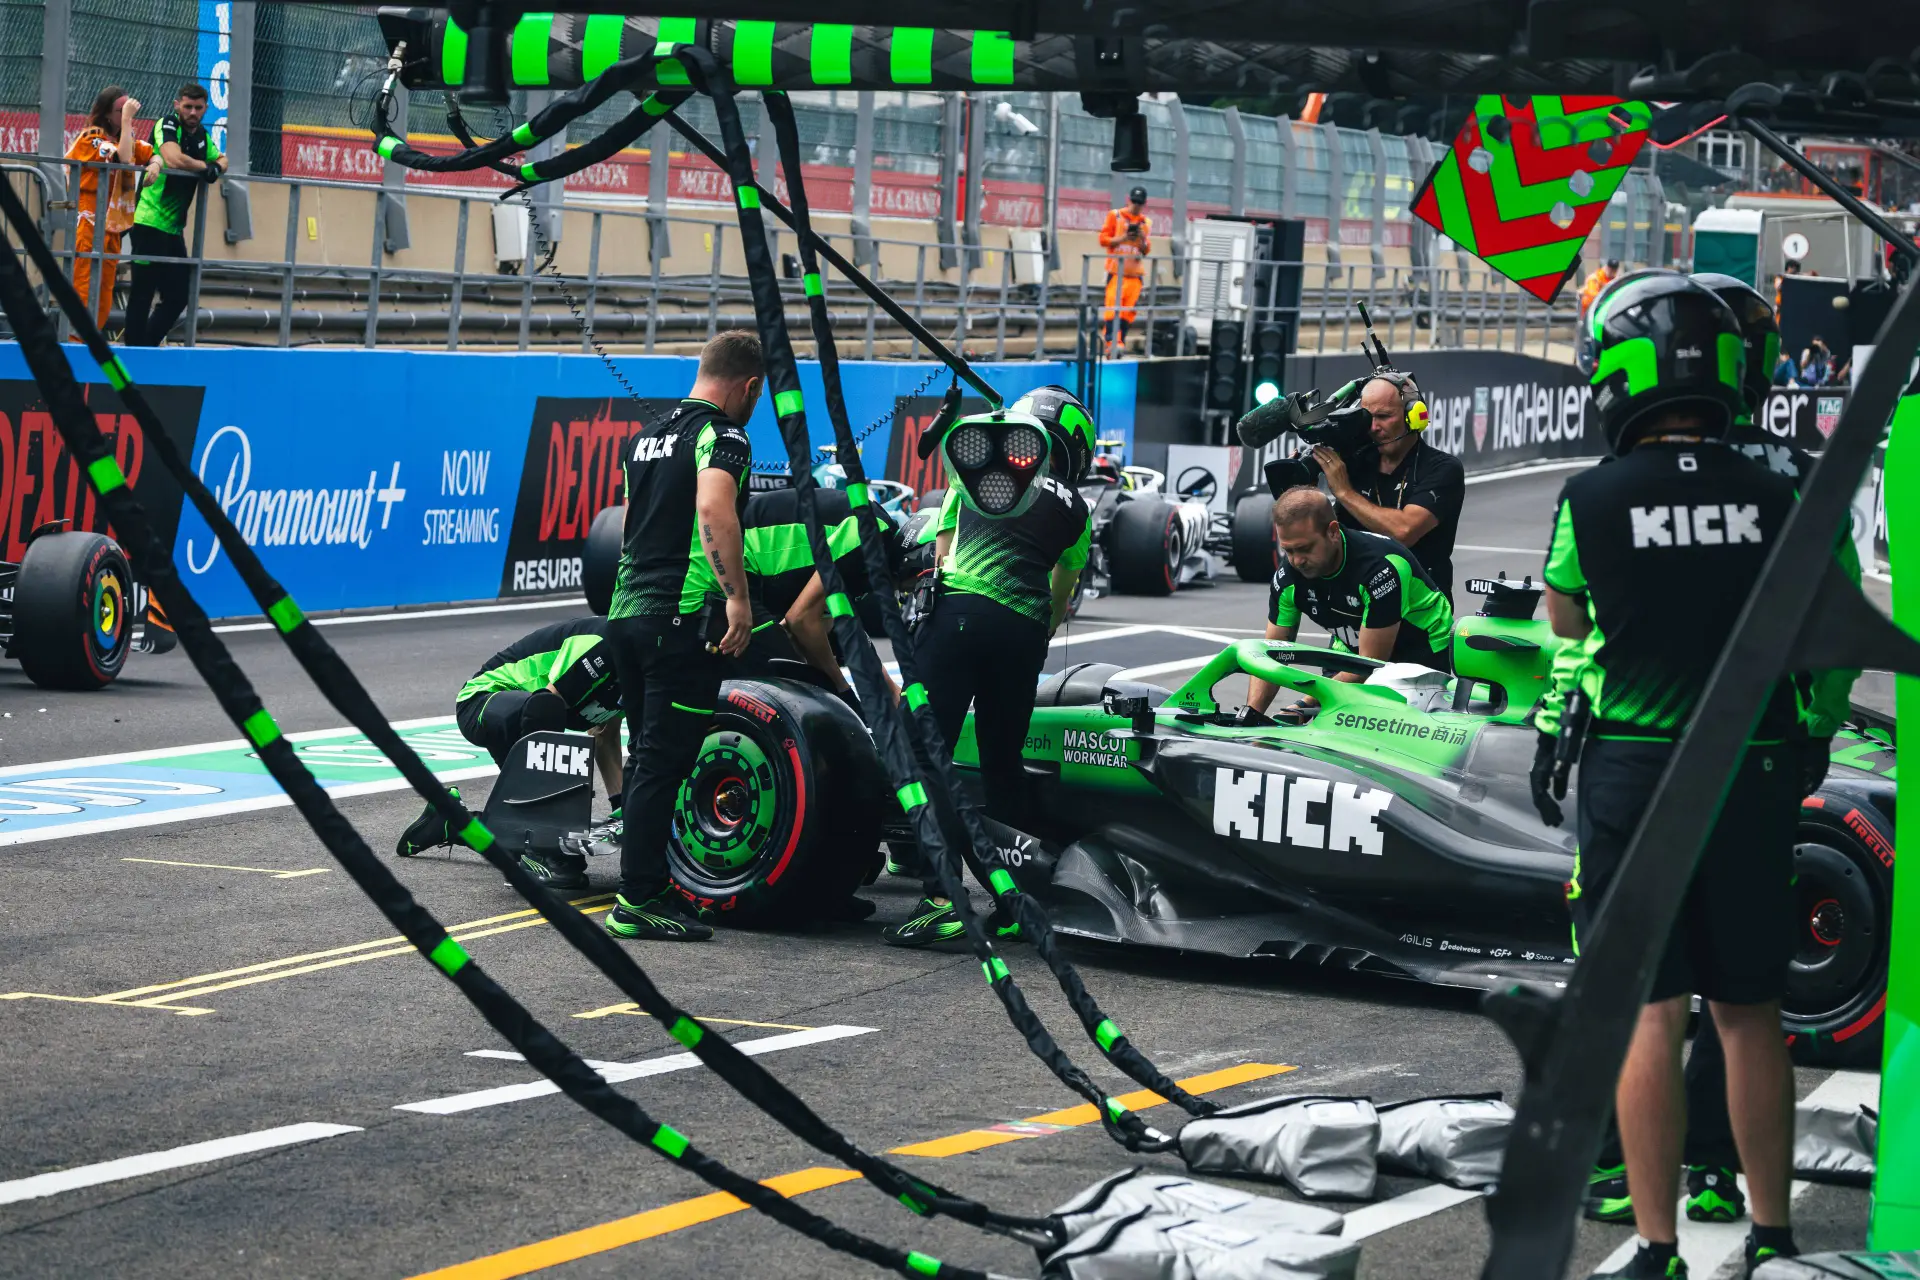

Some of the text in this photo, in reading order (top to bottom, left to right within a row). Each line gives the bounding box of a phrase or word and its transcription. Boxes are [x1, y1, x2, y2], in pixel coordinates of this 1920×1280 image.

[1793, 242, 1798, 253] 1
[633, 434, 678, 462] KICK
[442, 449, 490, 496] NOW
[187, 425, 406, 574] Paramount+
[422, 507, 499, 545] STREAMING
[1629, 504, 1762, 548] KICK
[513, 557, 583, 591] RESURR
[1372, 577, 1396, 596] MASCOT
[1470, 580, 1495, 594] HUL
[727, 688, 777, 723] PIRELLI
[1334, 712, 1430, 739] sensetime
[1431, 725, 1468, 746] 商汤
[1063, 729, 1126, 753] MASCOT
[526, 741, 590, 777] KICK
[1063, 749, 1127, 768] WORKWEAR
[1213, 767, 1394, 856] KICK
[1843, 808, 1896, 868] PIRELLI
[1399, 933, 1433, 948] AGILIS
[1447, 944, 1481, 954] edelweiss
